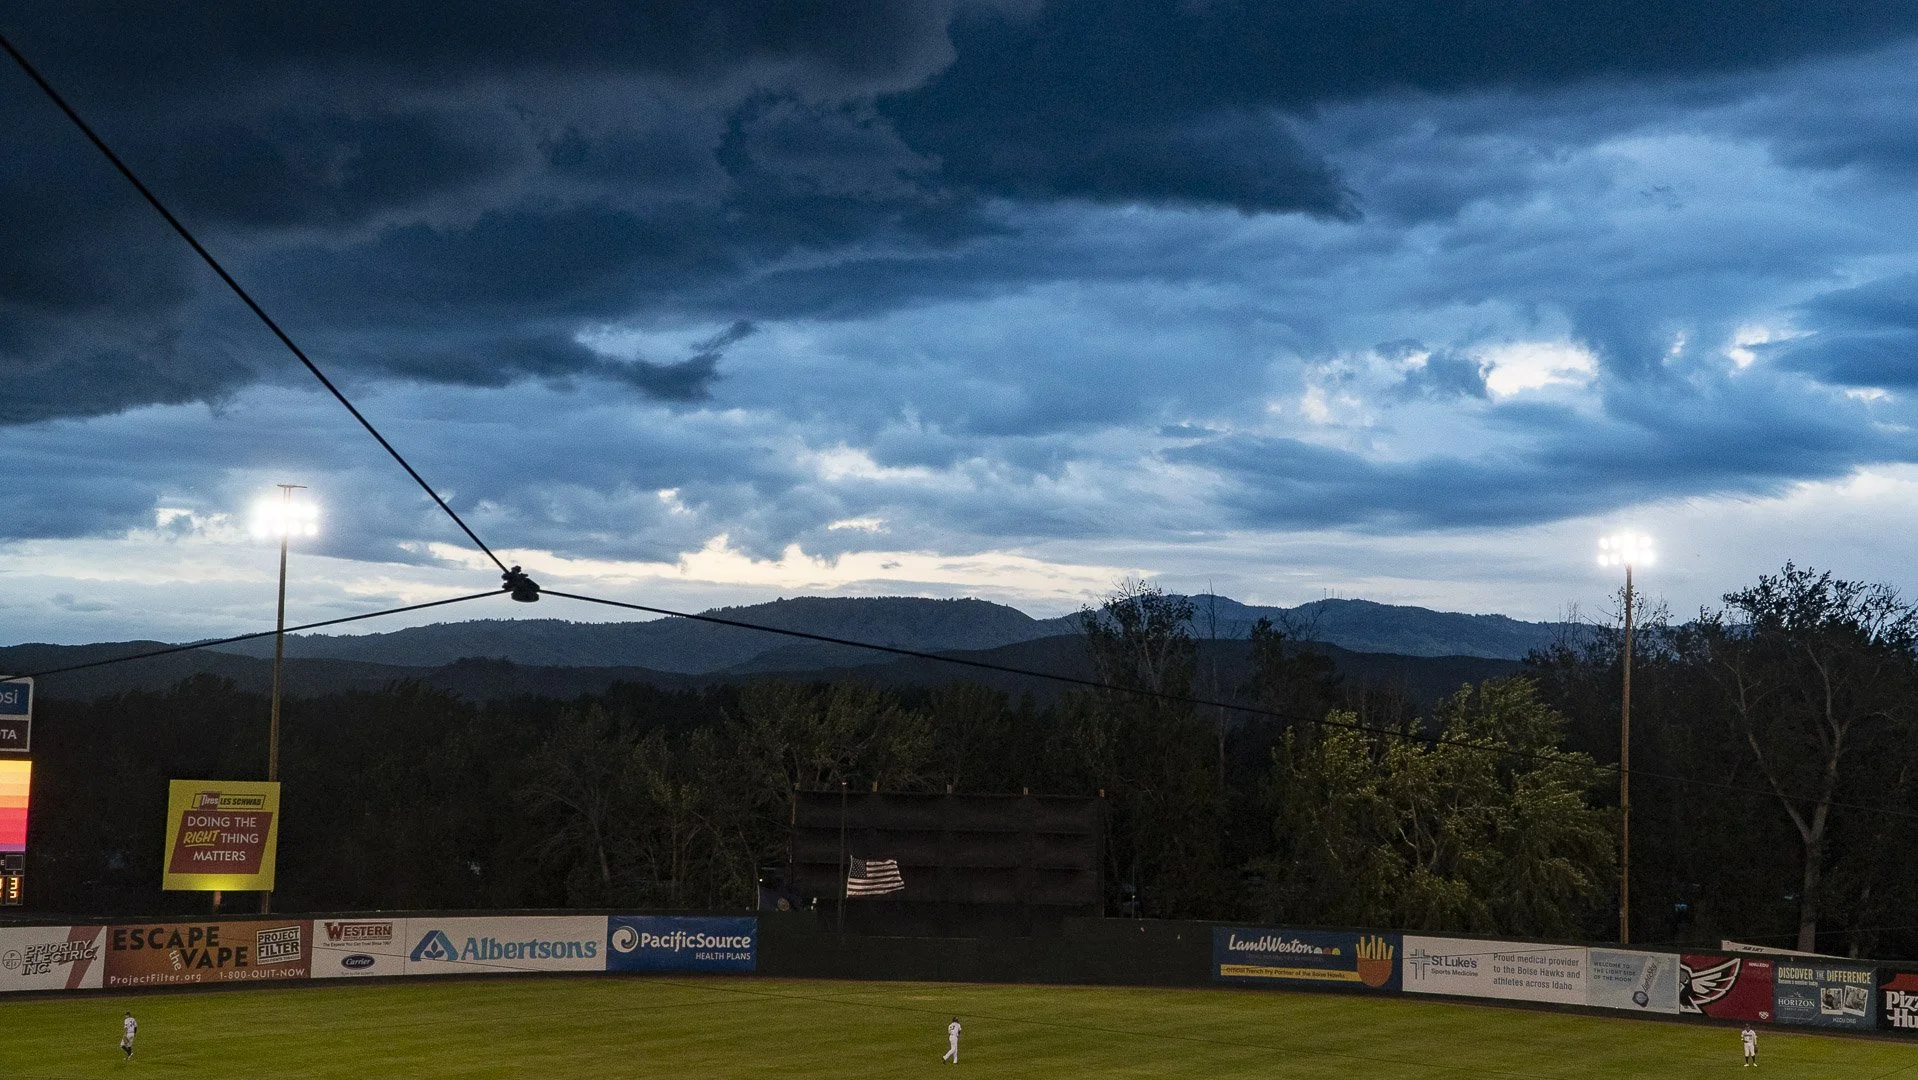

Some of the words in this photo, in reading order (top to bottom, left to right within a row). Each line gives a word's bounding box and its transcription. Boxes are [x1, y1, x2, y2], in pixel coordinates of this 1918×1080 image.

[200, 794, 219, 806] Tires
[220, 798, 230, 806] LES
[232, 798, 261, 806] SCHWAB
[187, 816, 230, 828] DOING
[234, 817, 257, 828] THE
[183, 829, 220, 844] RIGHT
[220, 833, 259, 844] THING
[193, 850, 246, 861] MATTERS
[113, 926, 219, 951] ESCAPE
[258, 930, 299, 943] PROJECT
[324, 922, 392, 941] WESTERN
[25, 940, 92, 956] PRIORITY
[640, 931, 751, 952] PacificSource
[258, 942, 299, 957] FILTER
[461, 937, 597, 961] Albertsons
[695, 952, 724, 960] HEALTH
[726, 952, 751, 960] PLANS
[168, 950, 182, 972] the
[179, 947, 248, 969] VAPE
[345, 958, 371, 966] Carrier
[1431, 955, 1444, 966] St
[1445, 955, 1478, 969] Luke's
[1493, 953, 1515, 962] Proud
[1517, 954, 1547, 965] medical
[1548, 956, 1579, 967] provider
[1593, 961, 1621, 969] WELCOME
[21, 963, 51, 976] INC.
[219, 968, 305, 980] 1-800-QUIT-NOW
[1431, 968, 1451, 976] Sports
[1451, 968, 1478, 977] Medicine
[1503, 965, 1515, 974] the
[1517, 966, 1538, 976] Boise
[1540, 968, 1565, 978] Hawks
[1566, 969, 1581, 979] and
[1778, 967, 1813, 980] DISCOVER
[1826, 969, 1872, 984] DIFFERENCE
[110, 973, 201, 986] ProjectFilter.org
[1493, 977, 1524, 987] athletes
[1525, 981, 1550, 989] across
[1552, 981, 1573, 991] Idaho
[1778, 998, 1815, 1007] HORIZON
